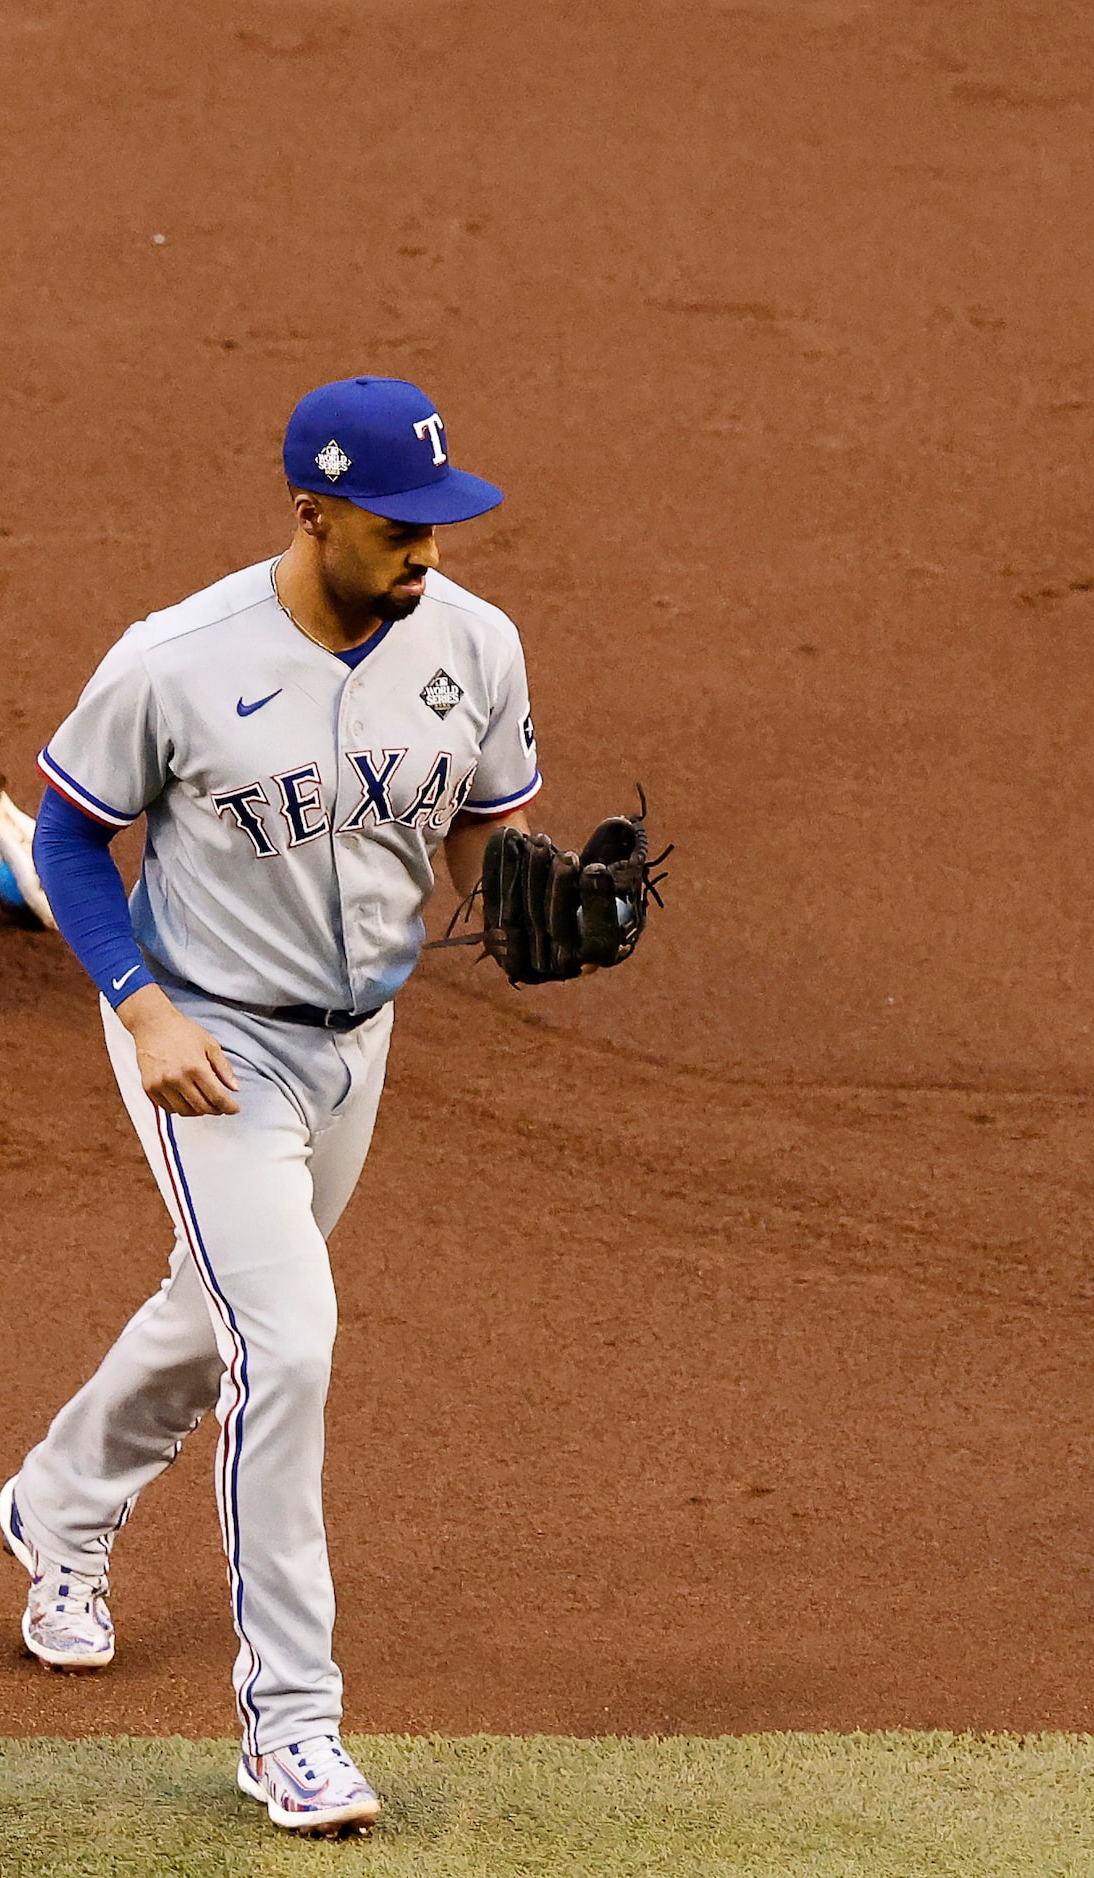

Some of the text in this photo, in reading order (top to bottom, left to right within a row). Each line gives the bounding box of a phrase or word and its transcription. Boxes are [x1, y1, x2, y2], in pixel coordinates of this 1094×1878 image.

[412, 411, 447, 467] T
[318, 453, 348, 464] WORLD
[426, 685, 459, 696] WORLD
[426, 694, 460, 705] SERIES
